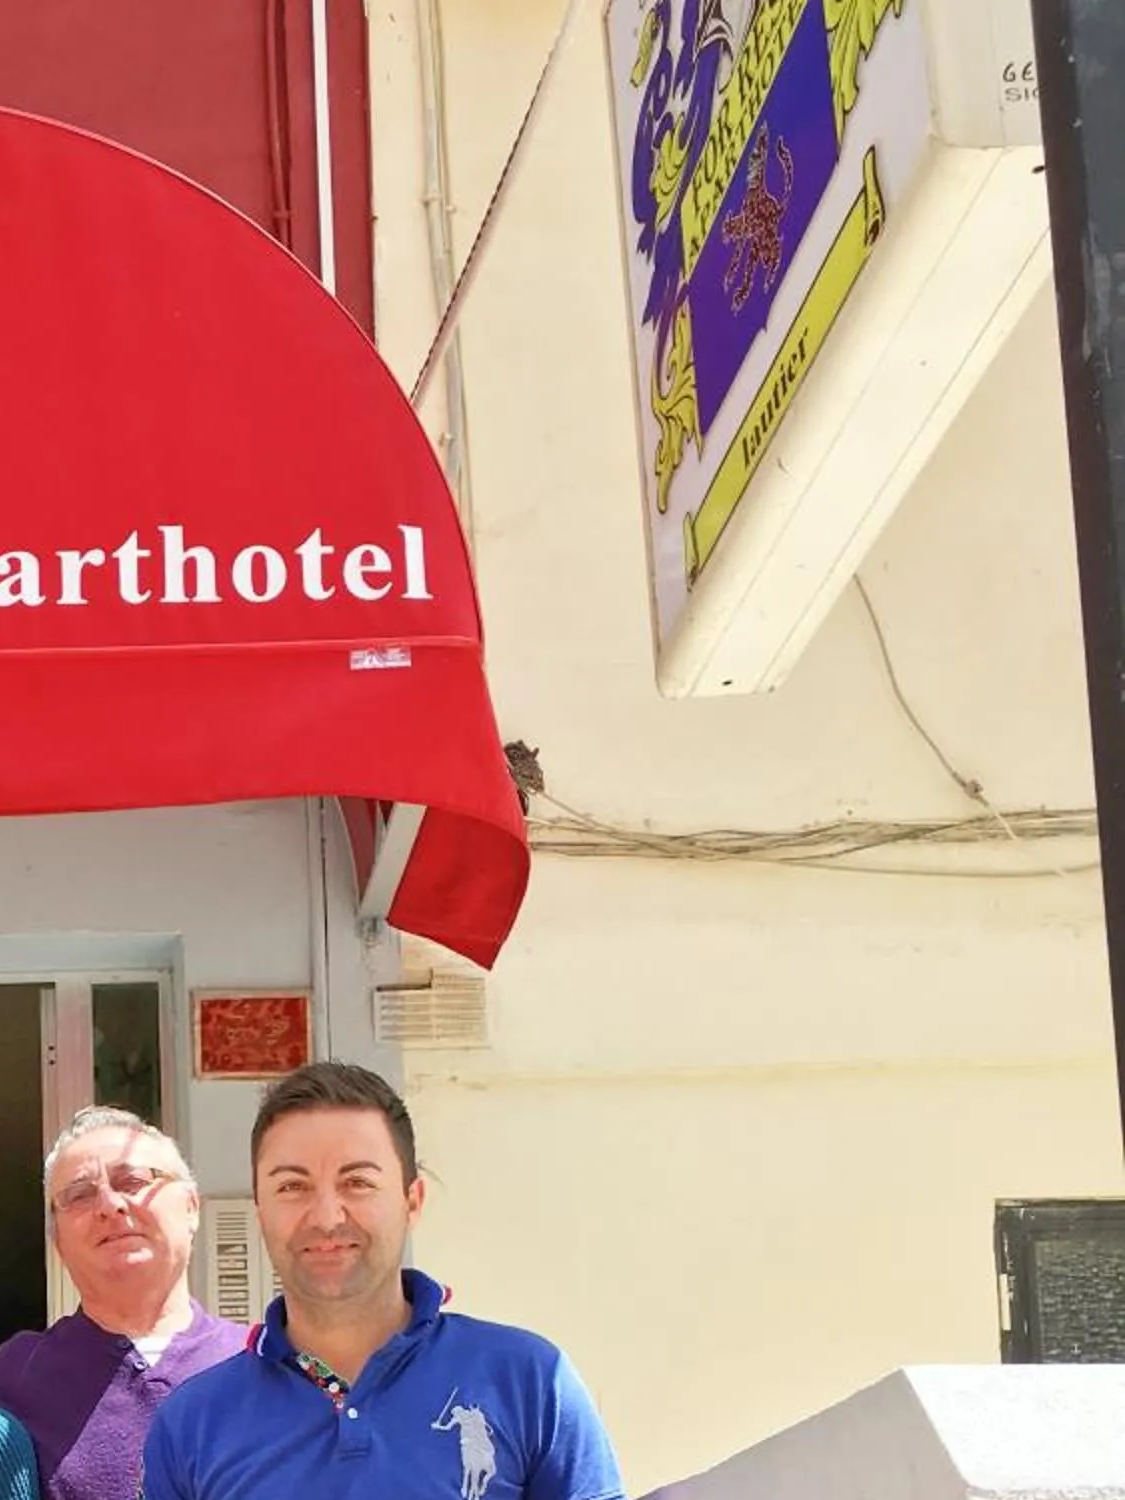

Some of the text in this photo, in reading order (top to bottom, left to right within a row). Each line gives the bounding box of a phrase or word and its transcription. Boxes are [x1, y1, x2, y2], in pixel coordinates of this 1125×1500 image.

[687, 0, 804, 267] APARTHOTE
[693, 0, 783, 218] FOR RE
